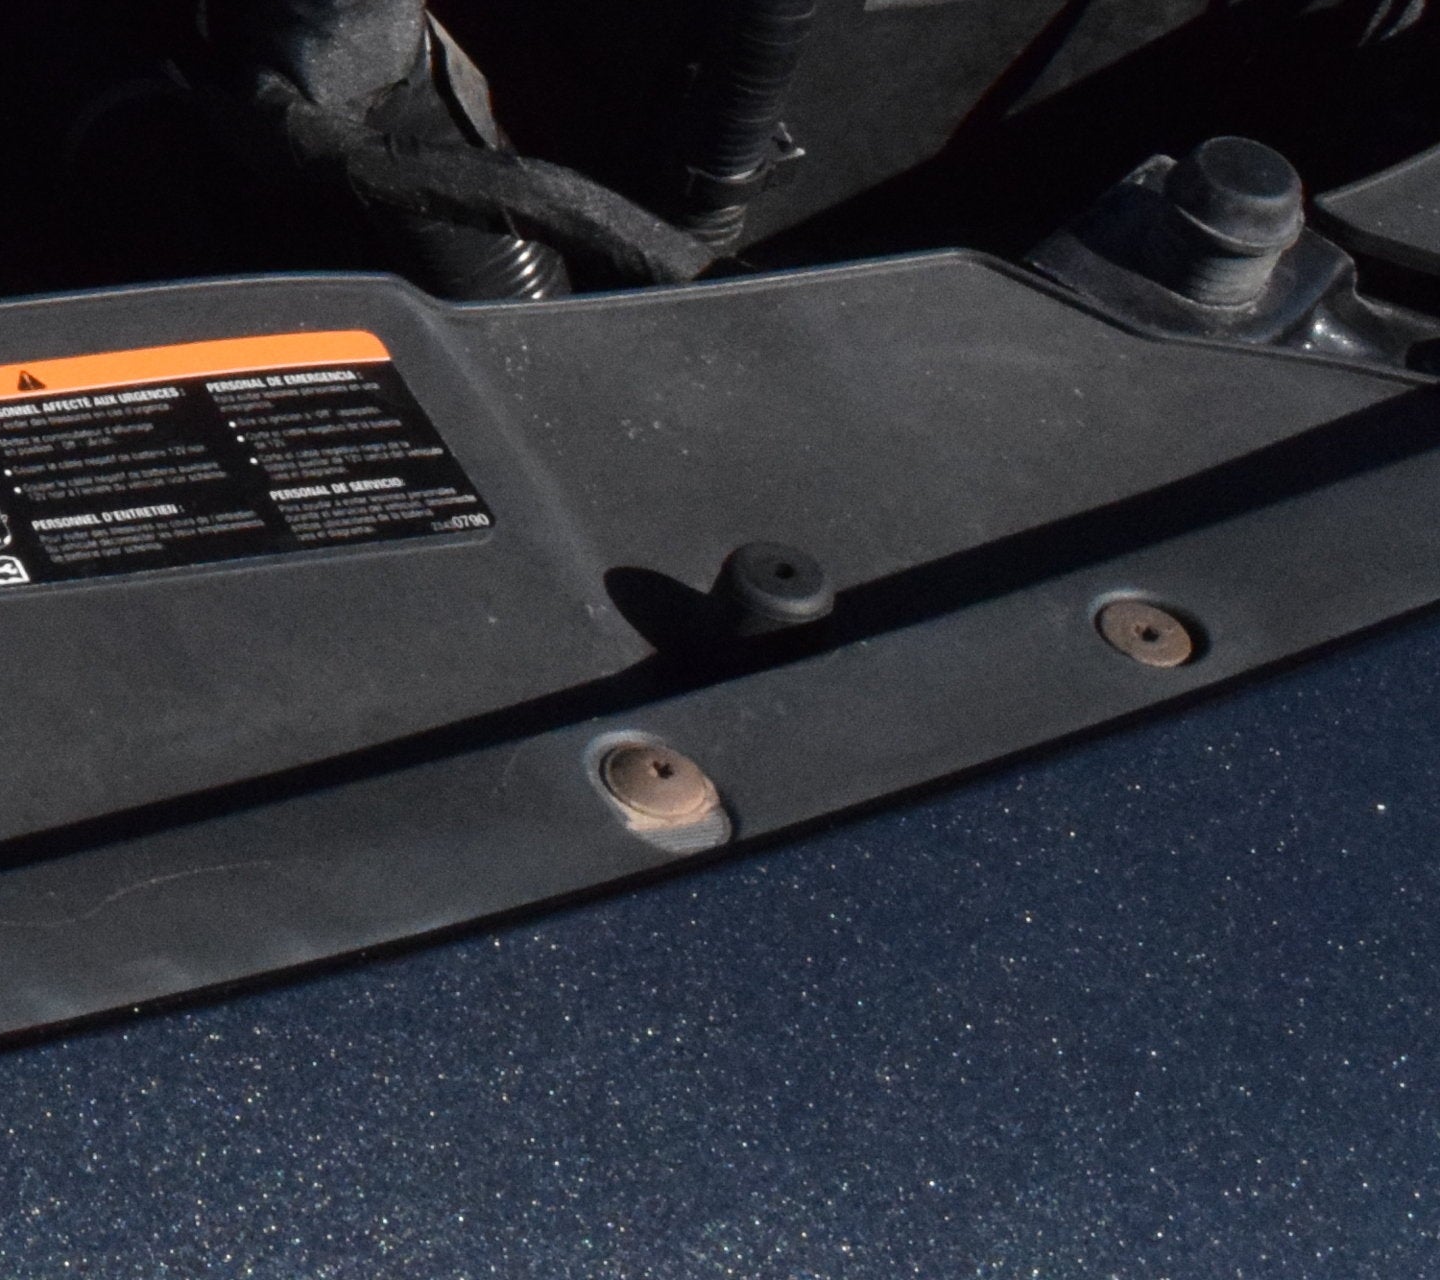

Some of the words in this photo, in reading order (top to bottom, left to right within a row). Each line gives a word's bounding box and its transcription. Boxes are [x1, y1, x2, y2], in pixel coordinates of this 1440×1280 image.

[206, 378, 267, 394] PERSONAL
[266, 376, 284, 388] DE
[284, 369, 357, 386] EMERGENCIA
[42, 398, 93, 413] AFFECTÉ
[93, 395, 118, 407] AUX
[118, 388, 180, 404] URGENCES
[270, 485, 331, 501] PERSONAL
[331, 483, 349, 494] DE
[349, 477, 406, 492] SERVICIO:
[31, 513, 102, 530] PERSONNEL
[101, 505, 179, 523] D'ENTRETIEN
